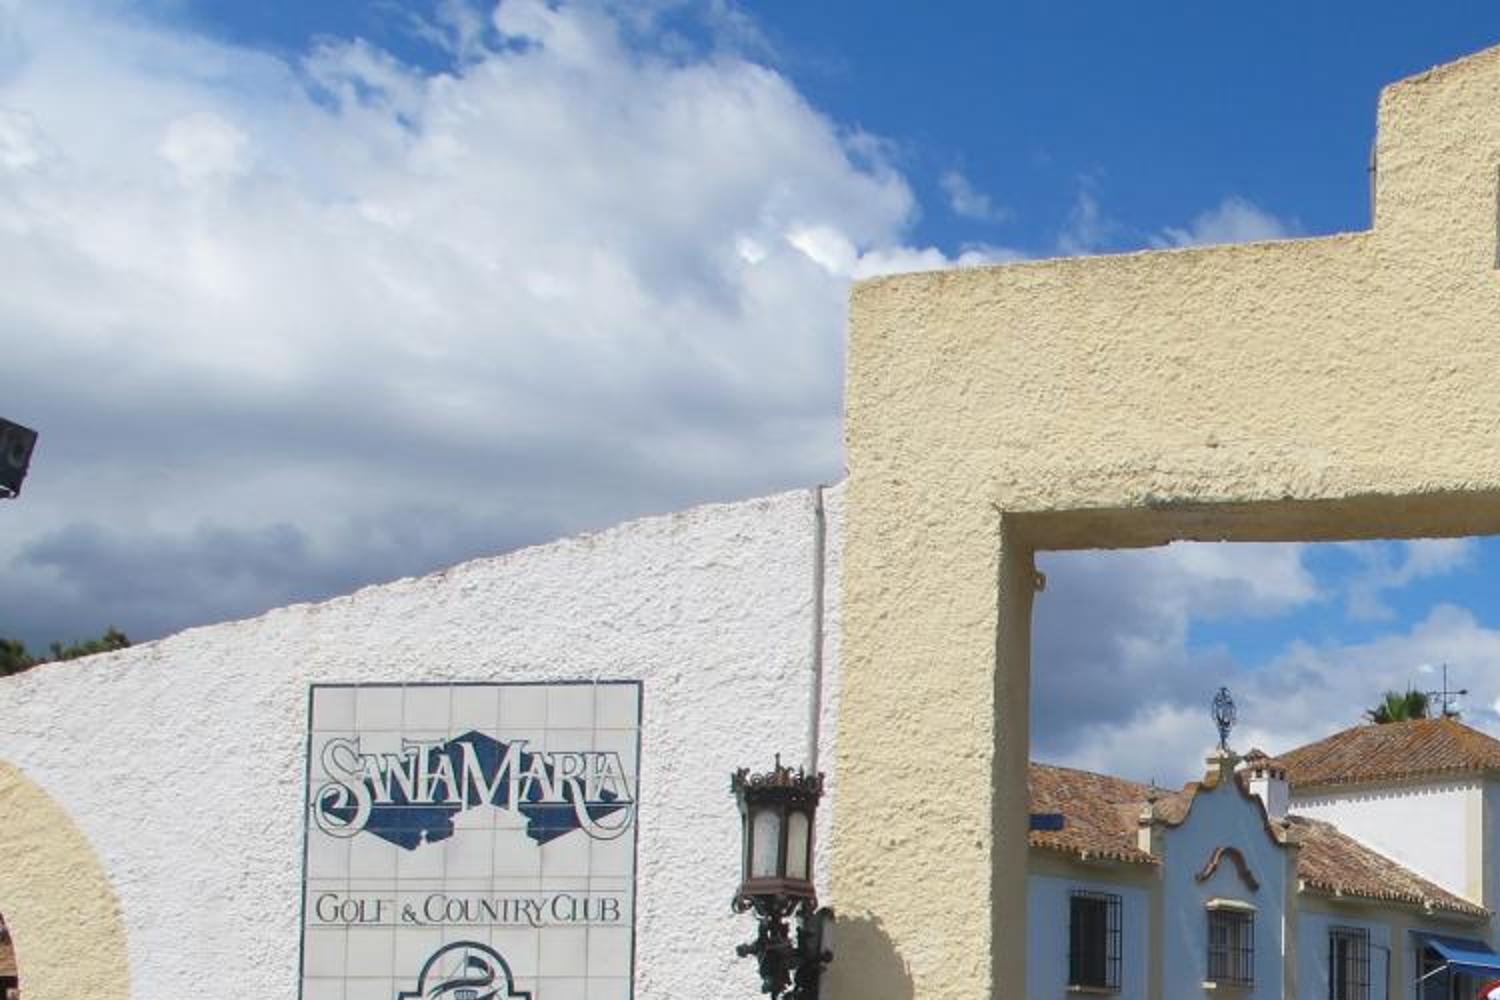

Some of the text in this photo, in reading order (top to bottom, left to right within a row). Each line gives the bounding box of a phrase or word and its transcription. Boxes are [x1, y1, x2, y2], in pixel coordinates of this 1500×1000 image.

[316, 894, 620, 928] GOLF & COUNTRY CLUB
